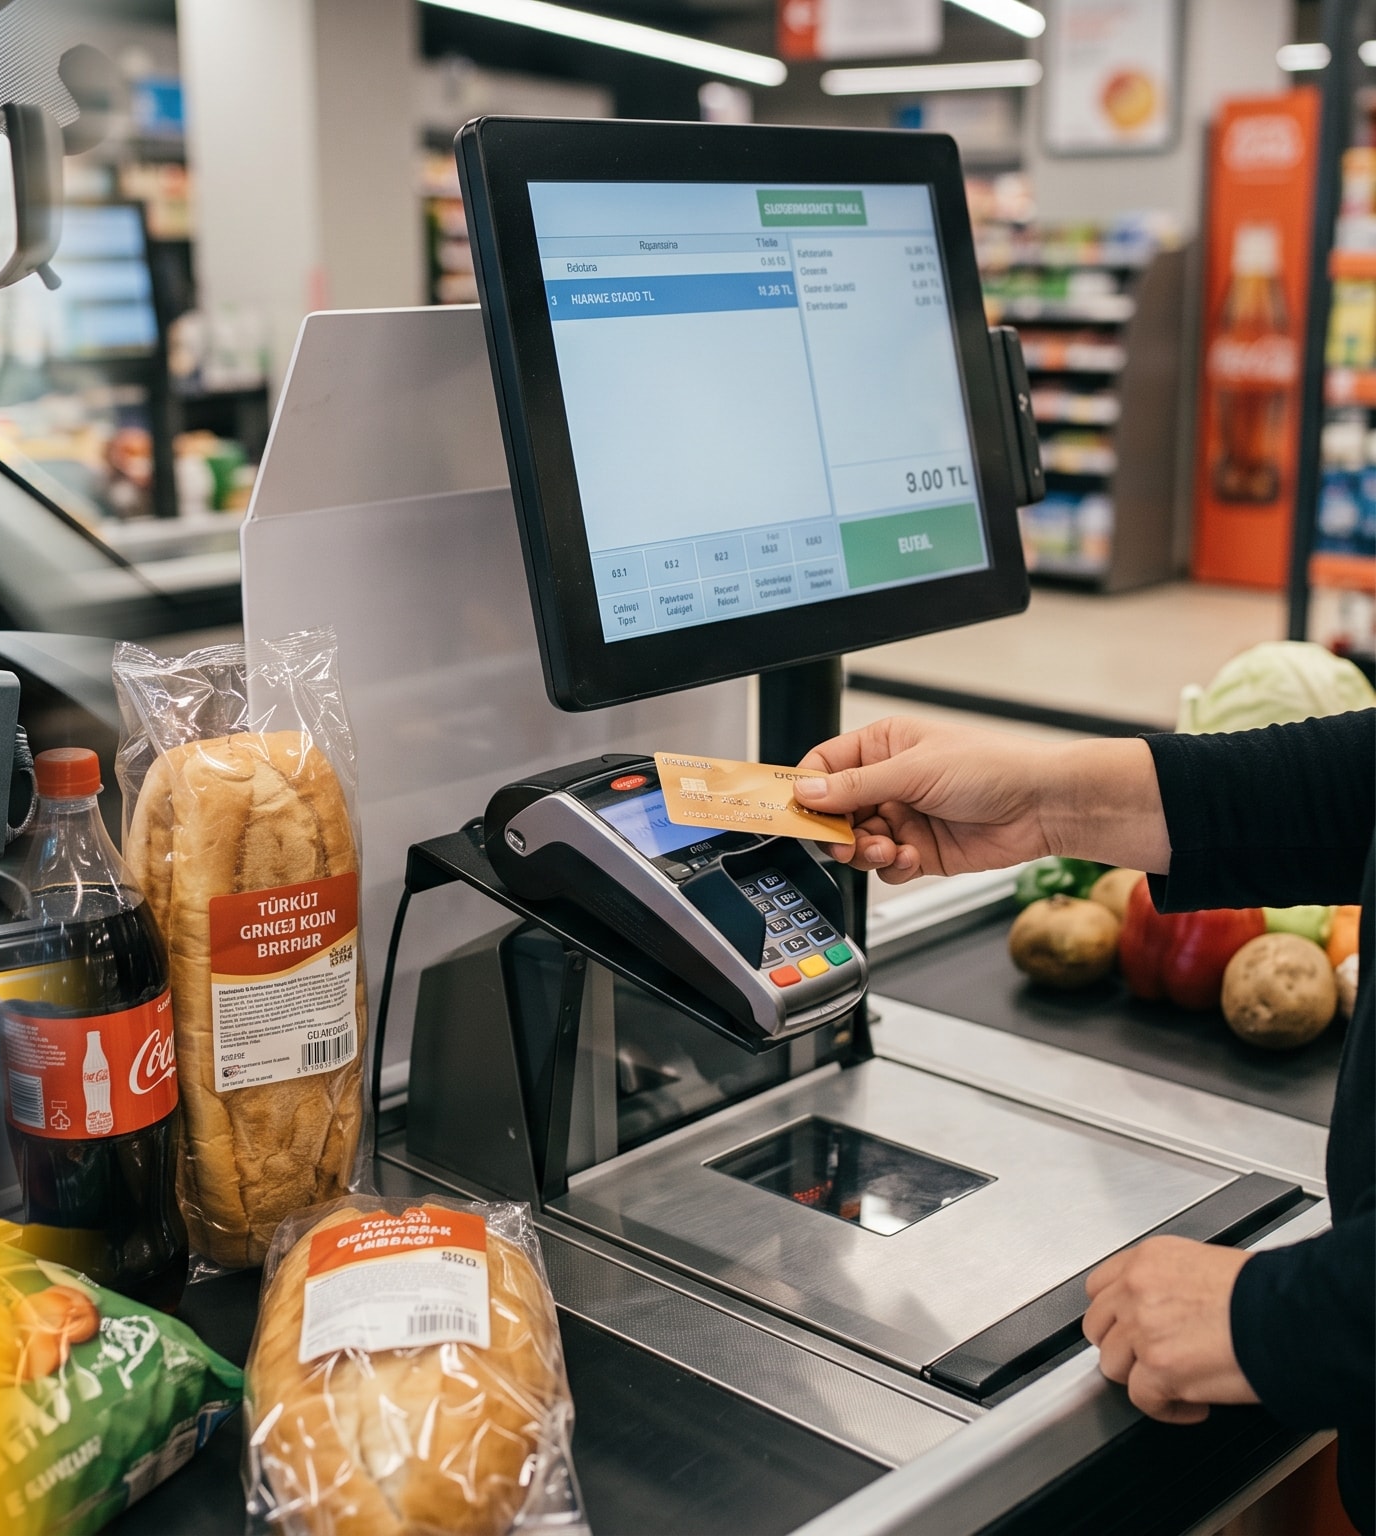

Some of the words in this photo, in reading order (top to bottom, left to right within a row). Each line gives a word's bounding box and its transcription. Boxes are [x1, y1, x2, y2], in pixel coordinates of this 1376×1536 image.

[551, 296, 558, 306] 3
[642, 291, 655, 302] TL
[906, 468, 944, 493] 3.00
[947, 465, 969, 487] TL
[300, 909, 337, 931] KOIN
